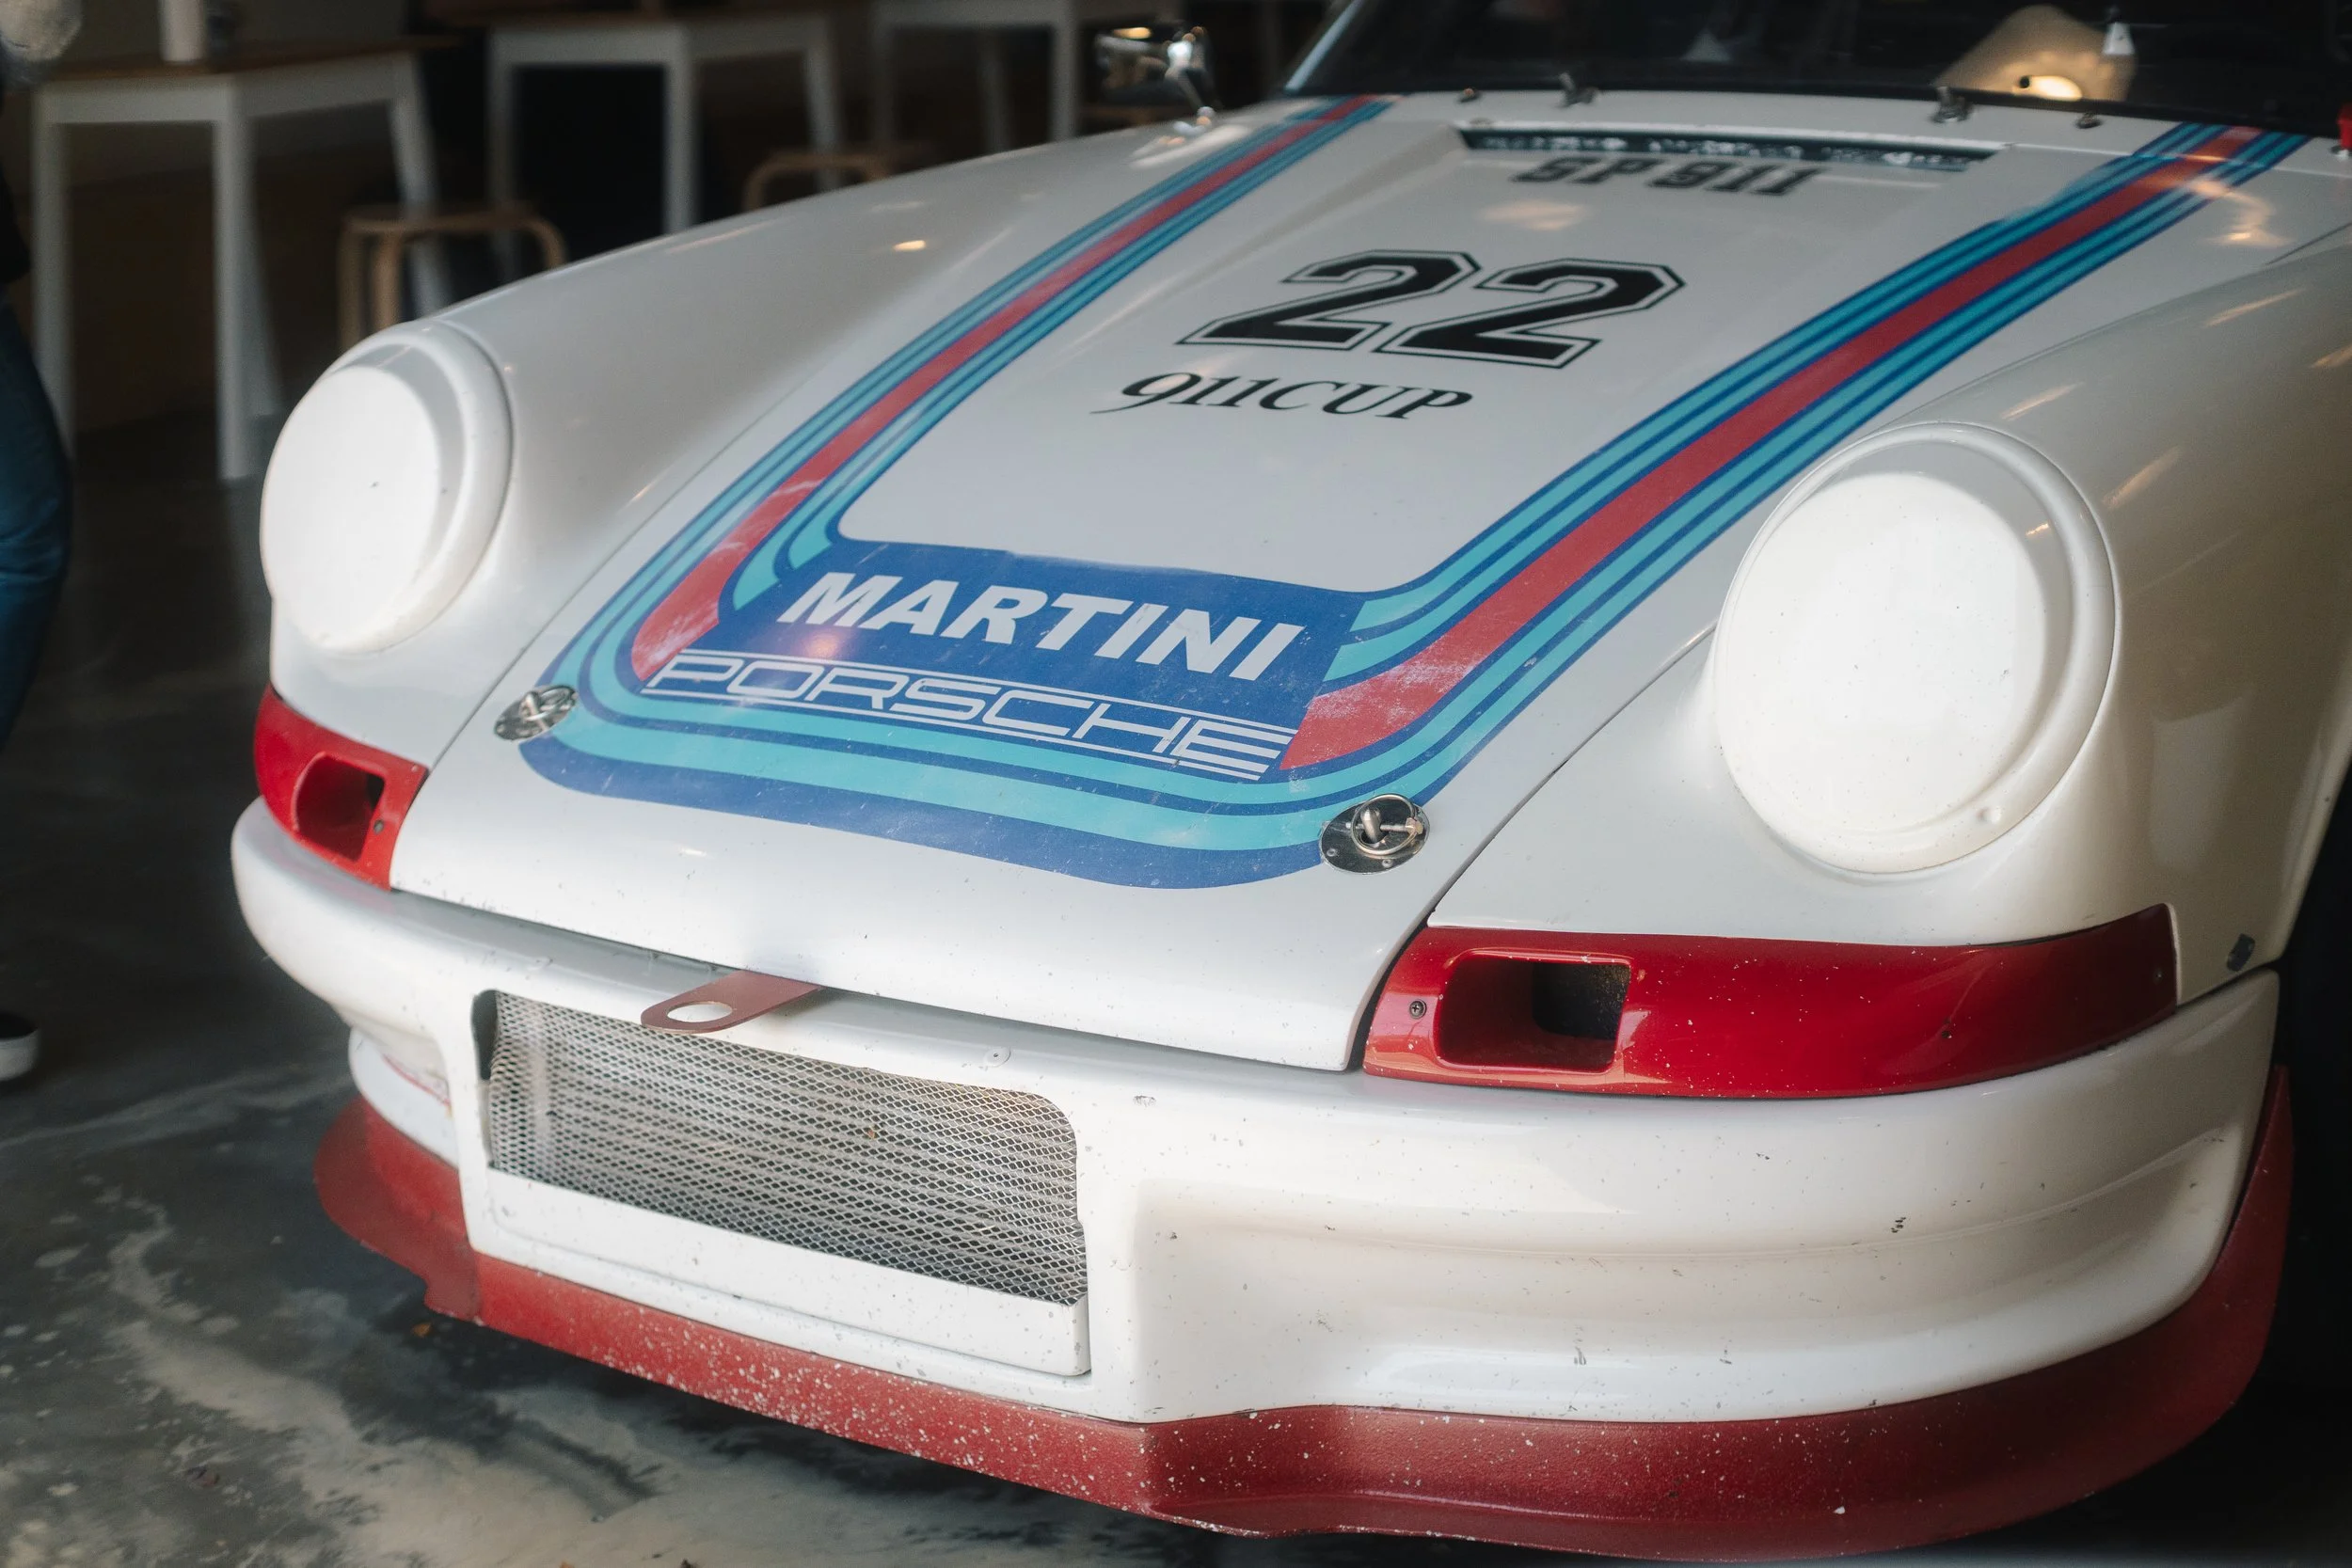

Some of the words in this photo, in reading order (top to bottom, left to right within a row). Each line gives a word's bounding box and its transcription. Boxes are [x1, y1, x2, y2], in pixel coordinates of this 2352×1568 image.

[1176, 248, 1687, 369] 22
[777, 571, 1304, 681] MARTINI
[647, 656, 1298, 782] PORSCHE
